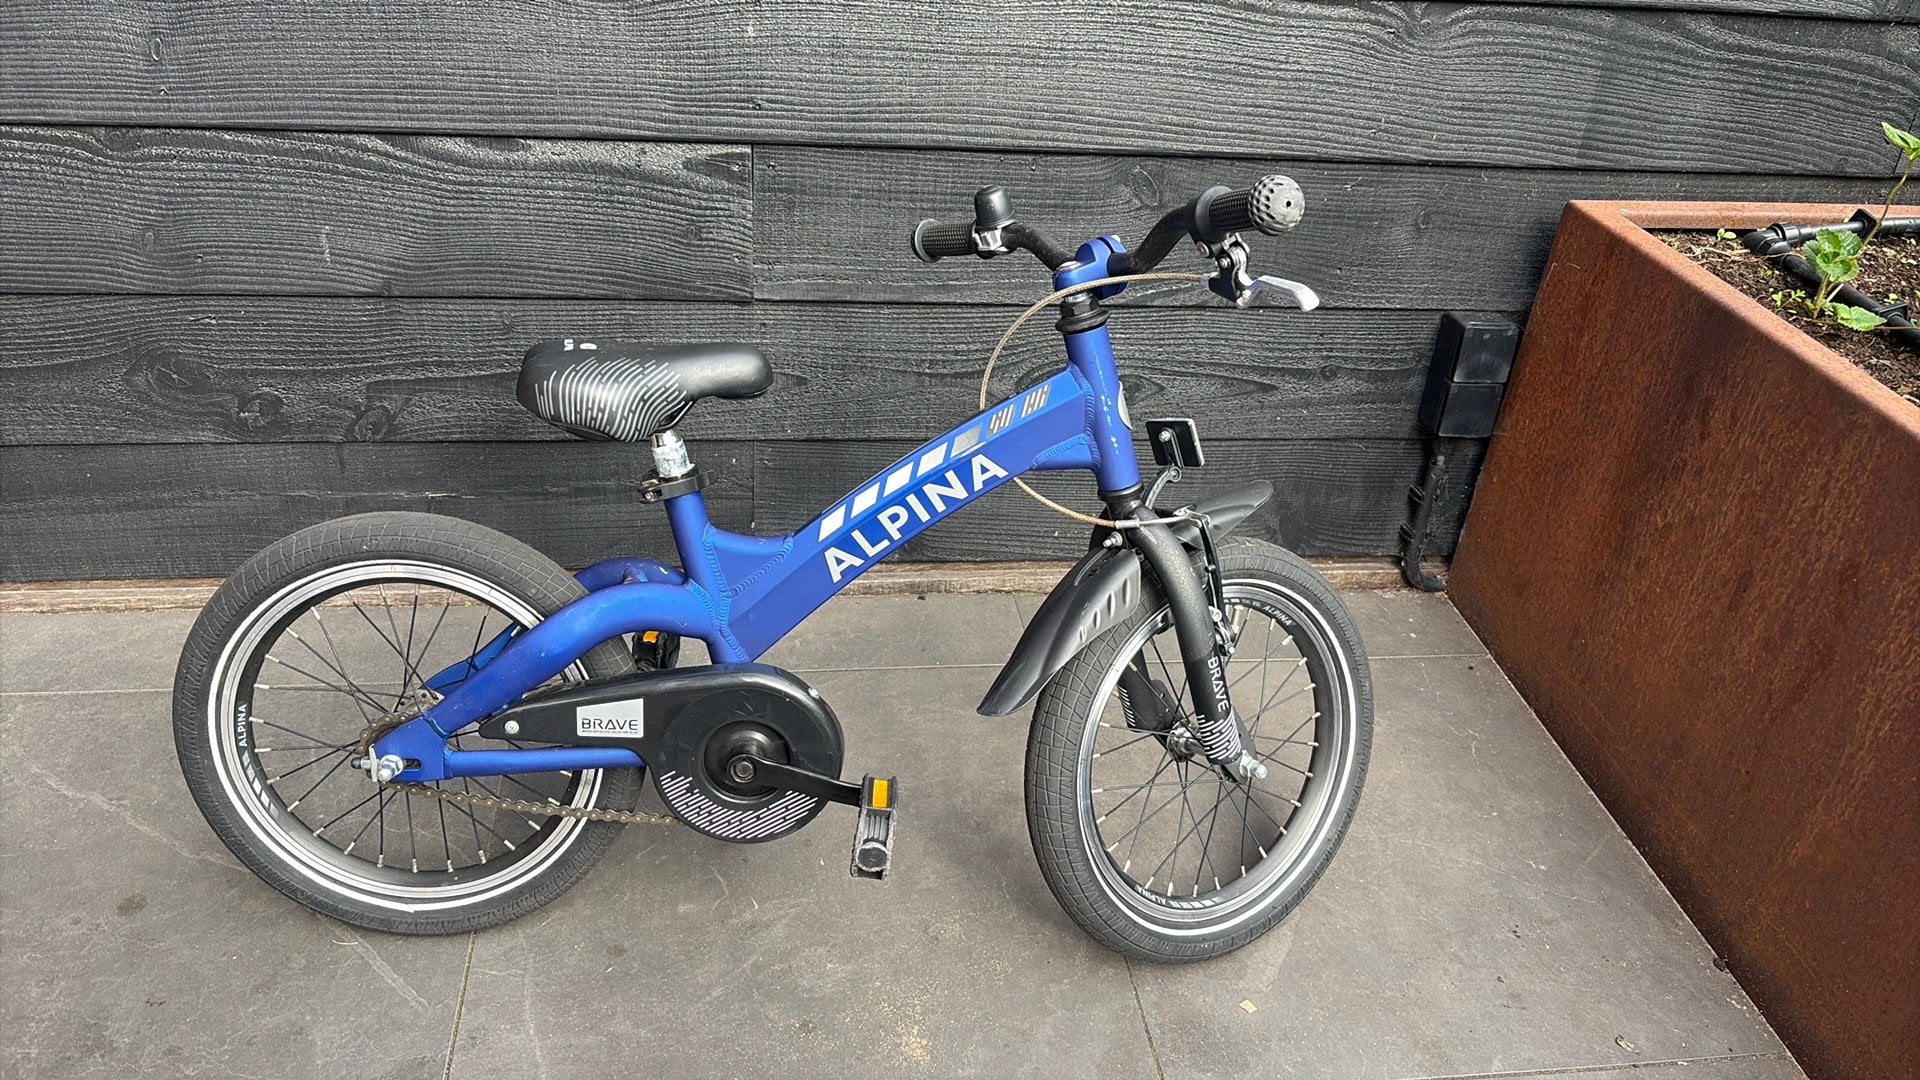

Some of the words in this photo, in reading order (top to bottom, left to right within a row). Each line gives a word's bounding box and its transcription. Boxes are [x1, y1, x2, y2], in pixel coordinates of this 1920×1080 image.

[824, 453, 1009, 584] ALPINA
[1262, 605, 1292, 626] ALPINA
[1208, 656, 1229, 712] BRAVE
[237, 704, 248, 747] ALPINA
[581, 717, 638, 731] BRAVE
